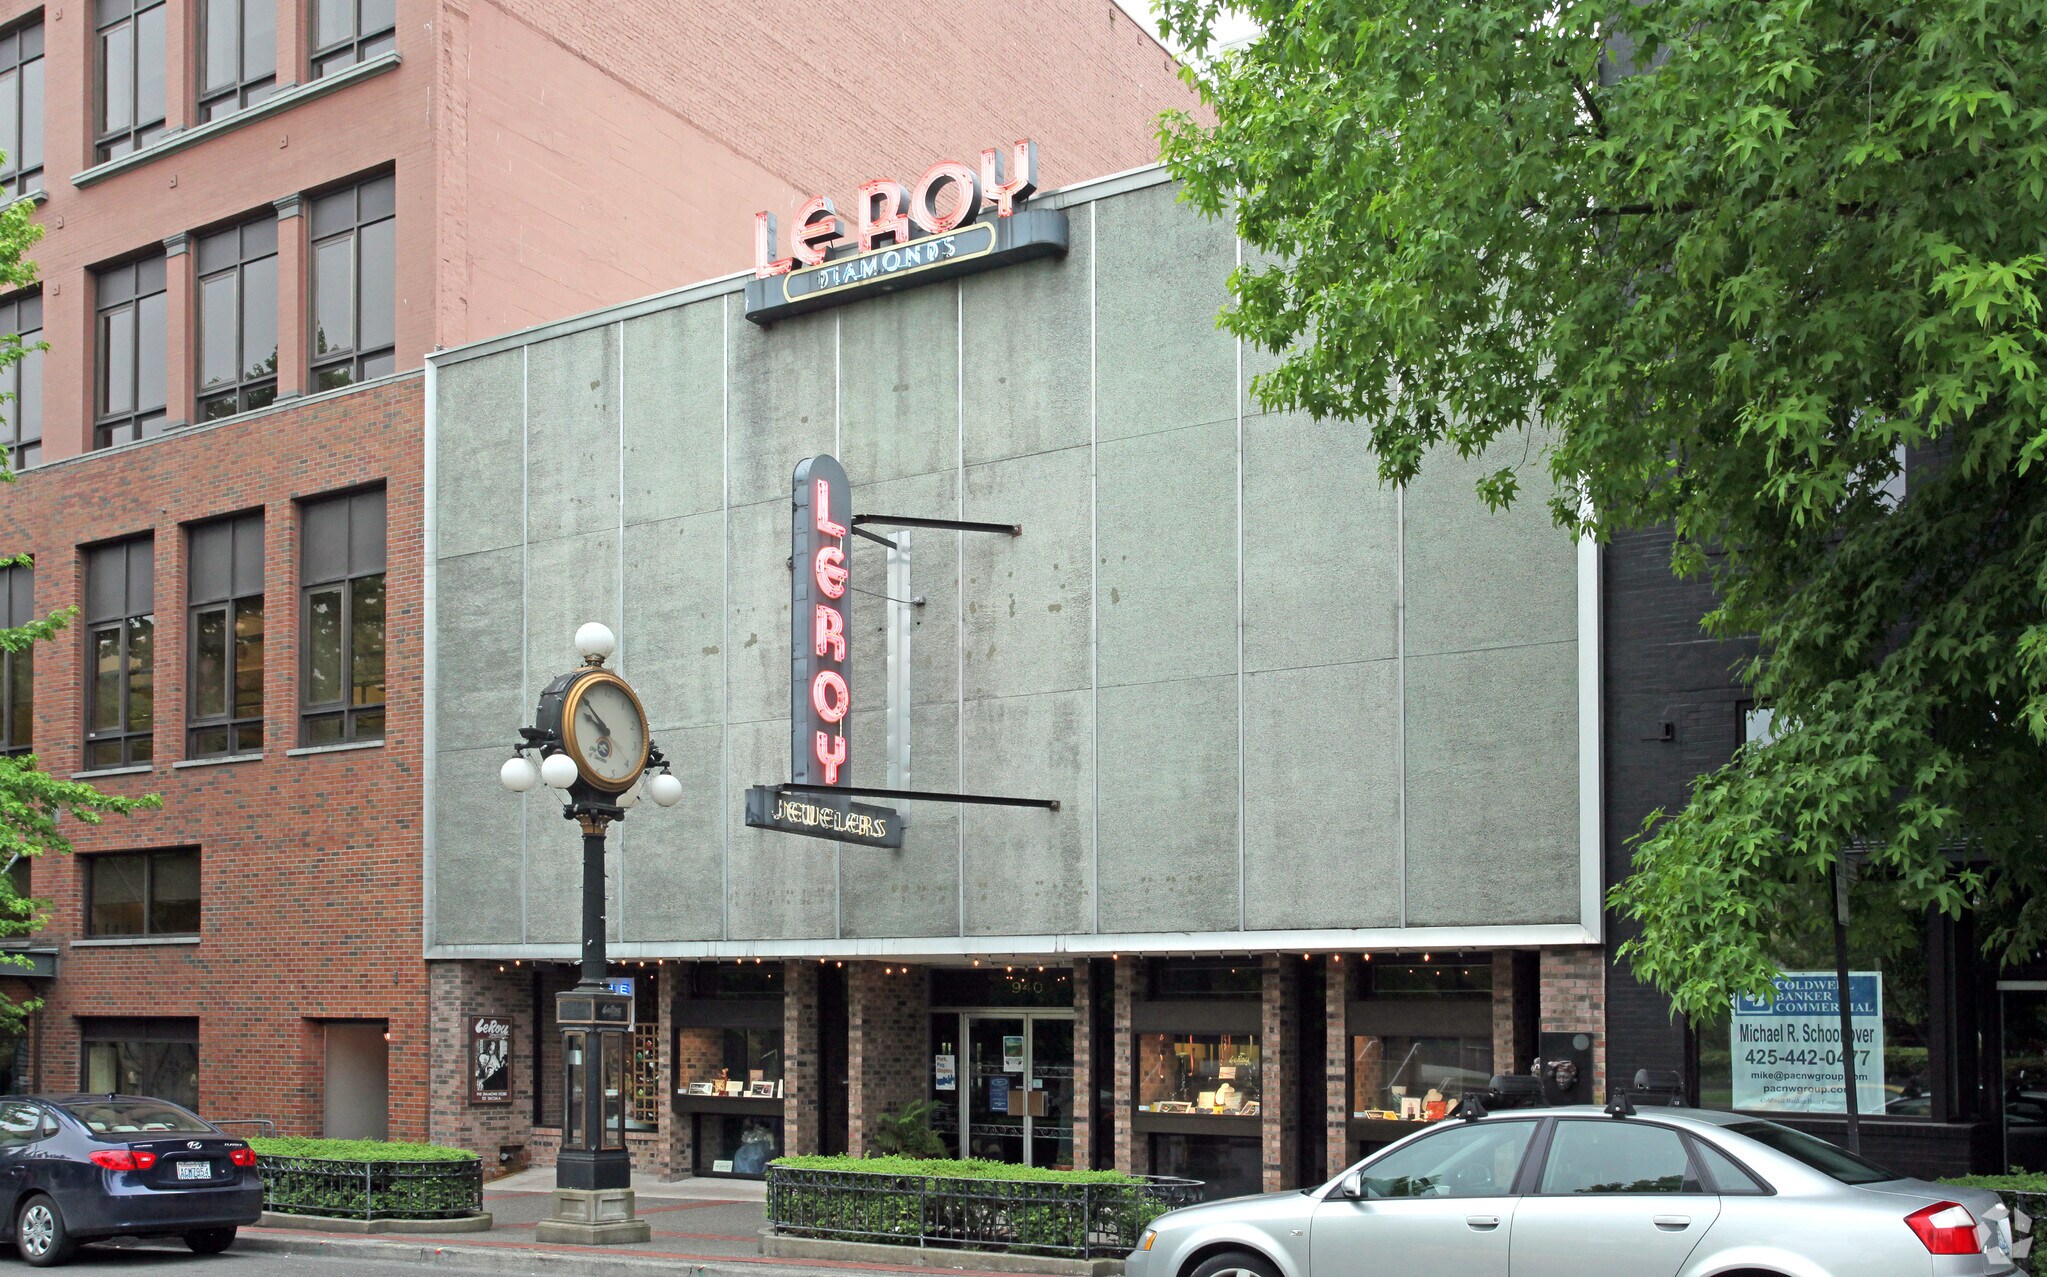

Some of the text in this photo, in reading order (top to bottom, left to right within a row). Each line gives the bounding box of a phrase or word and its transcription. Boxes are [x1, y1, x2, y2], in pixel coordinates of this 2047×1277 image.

[817, 236, 956, 289] DIAMONDS
[772, 799, 886, 838] JEWELERS
[1012, 981, 1043, 993] 940
[1775, 980, 1855, 991] COLDWE
[1776, 991, 1833, 1001] BANKER
[1776, 1002, 1874, 1012] COMMERIAL
[475, 1018, 509, 1034] LeRoy
[1739, 1023, 1875, 1043] Michael R. Schooover
[1751, 1071, 1868, 1082] mike@pacnwgroupom
[1763, 1084, 1847, 1094] pacnwgroup.co
